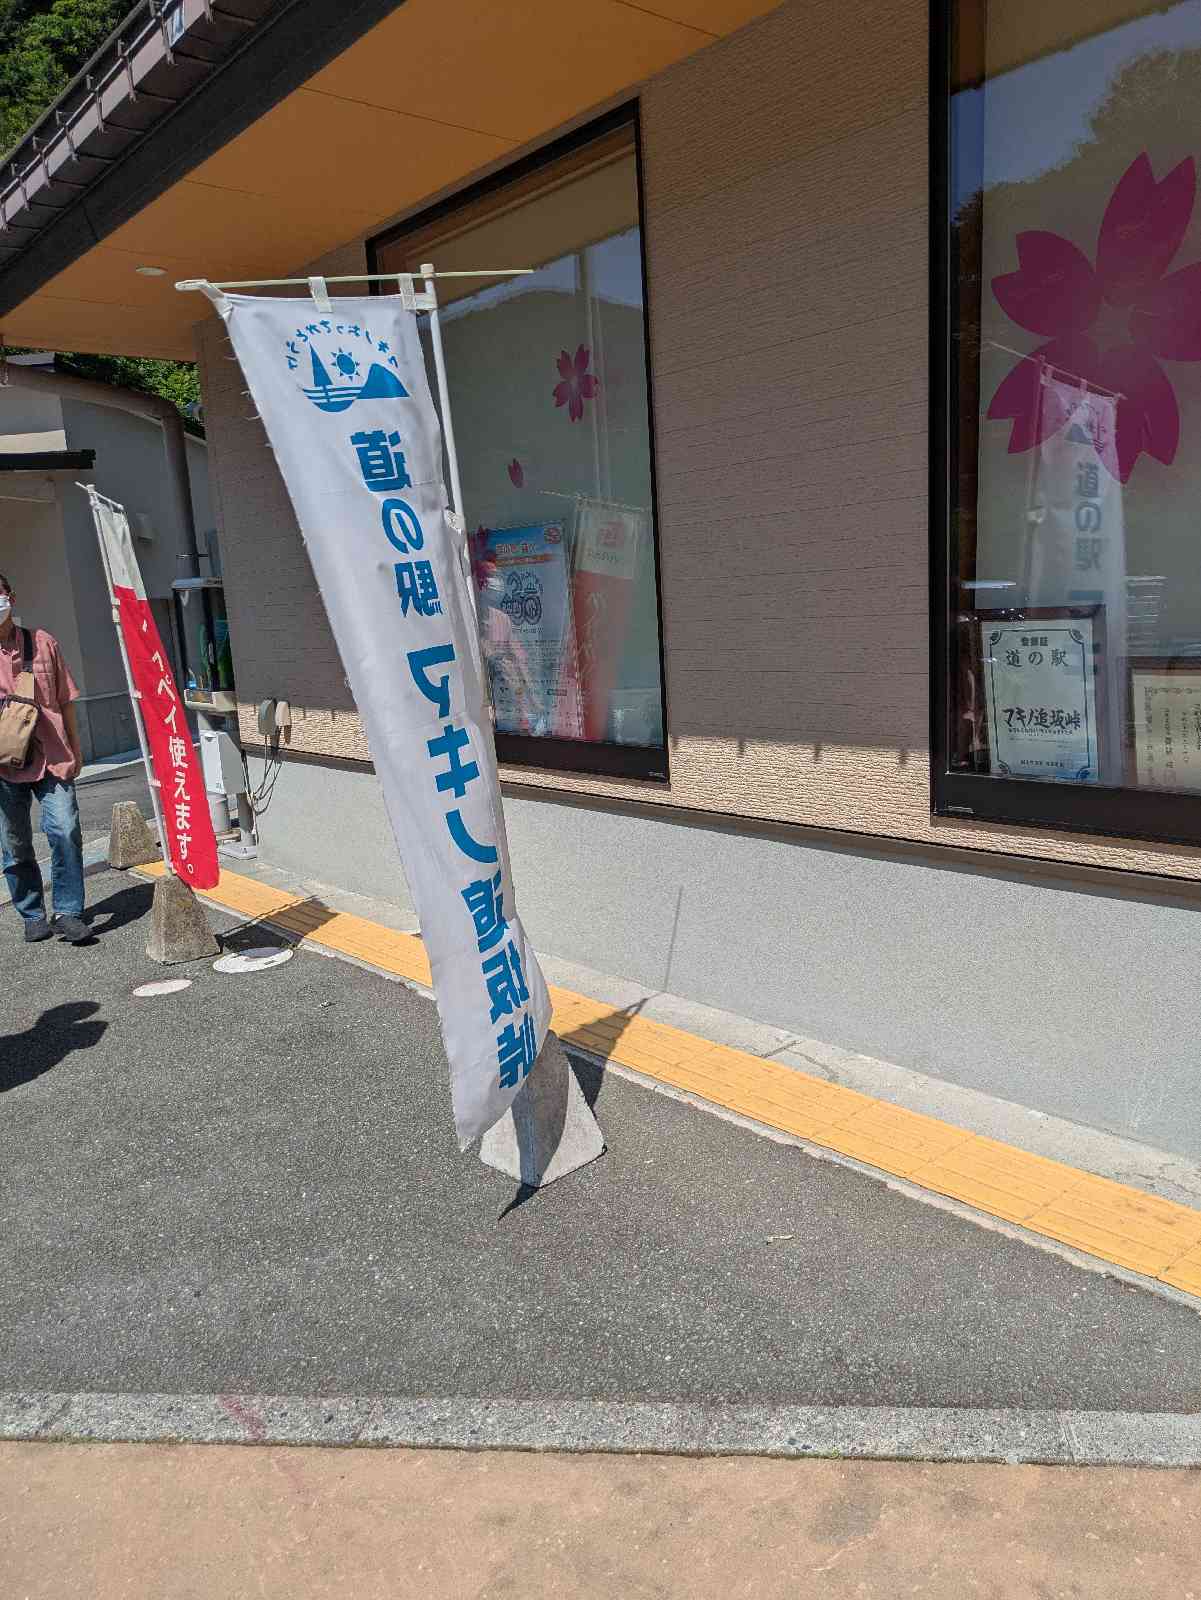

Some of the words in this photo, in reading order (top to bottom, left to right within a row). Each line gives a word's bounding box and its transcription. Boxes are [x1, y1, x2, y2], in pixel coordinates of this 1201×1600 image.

[1005, 650, 1069, 668] 道の駅
[1003, 707, 1081, 731] マキノ追坂峠
